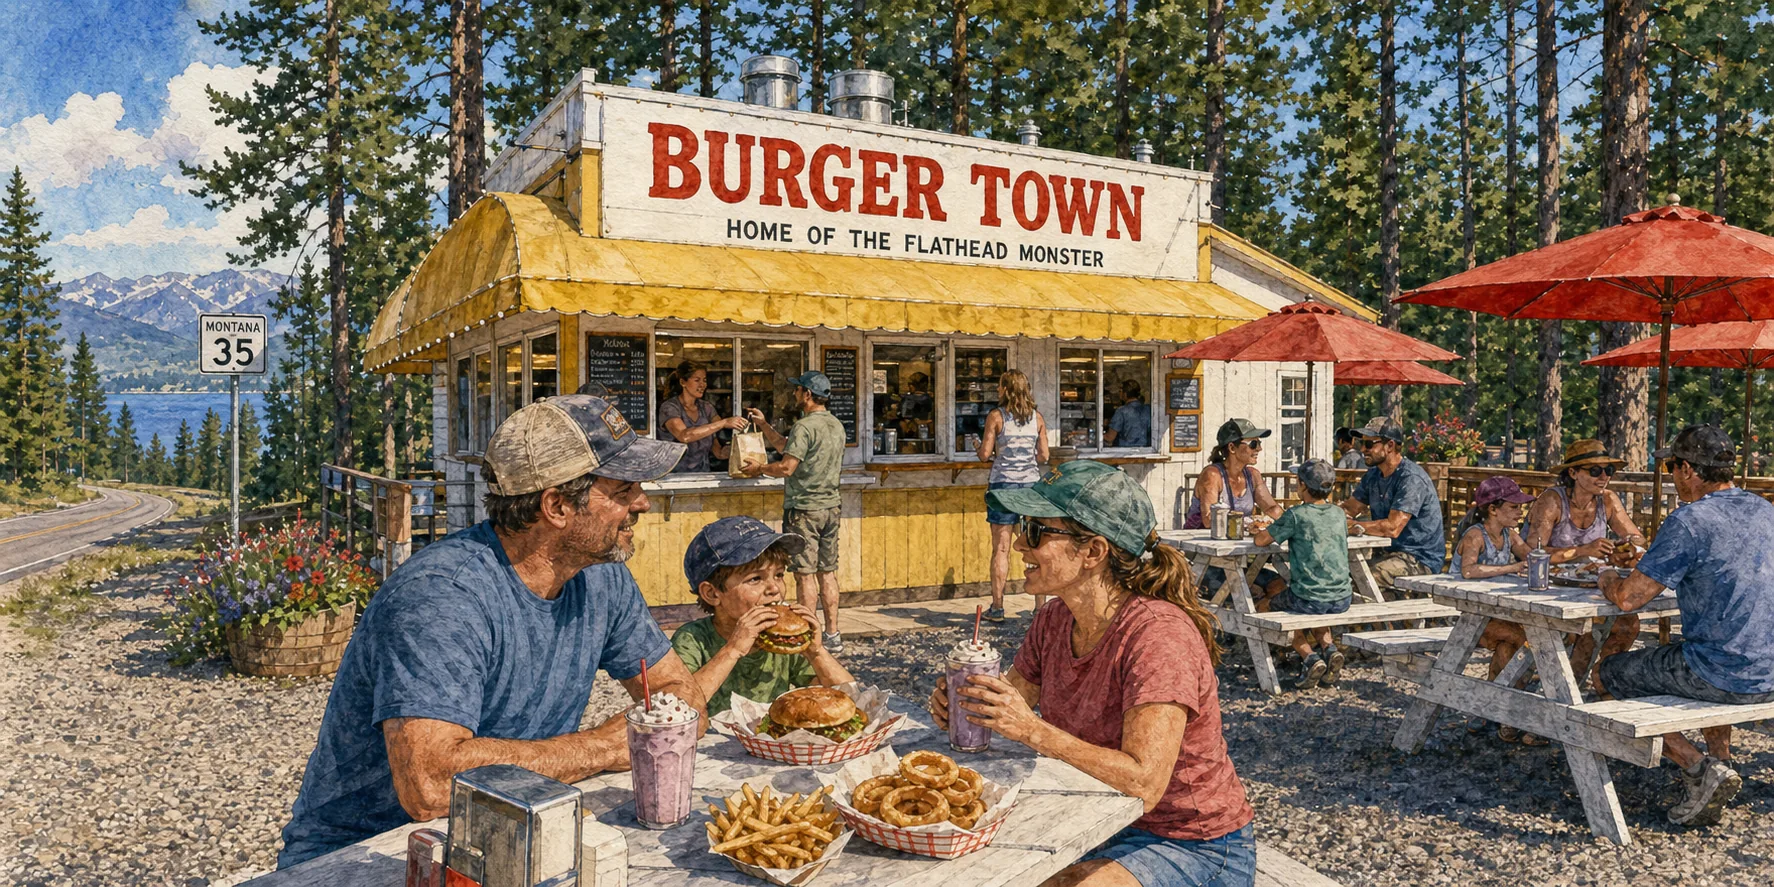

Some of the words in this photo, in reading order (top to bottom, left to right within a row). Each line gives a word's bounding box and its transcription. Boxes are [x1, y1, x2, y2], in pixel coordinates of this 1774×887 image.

[648, 122, 948, 223] BURGER
[970, 163, 1145, 242] TOWN
[727, 218, 793, 243] HOME
[807, 225, 836, 246] OF
[849, 229, 891, 251] THE
[904, 234, 1008, 260] FLATHEAD
[1019, 244, 1104, 268] MONSTER
[205, 321, 261, 333] MONTANA
[212, 337, 254, 366] 35
